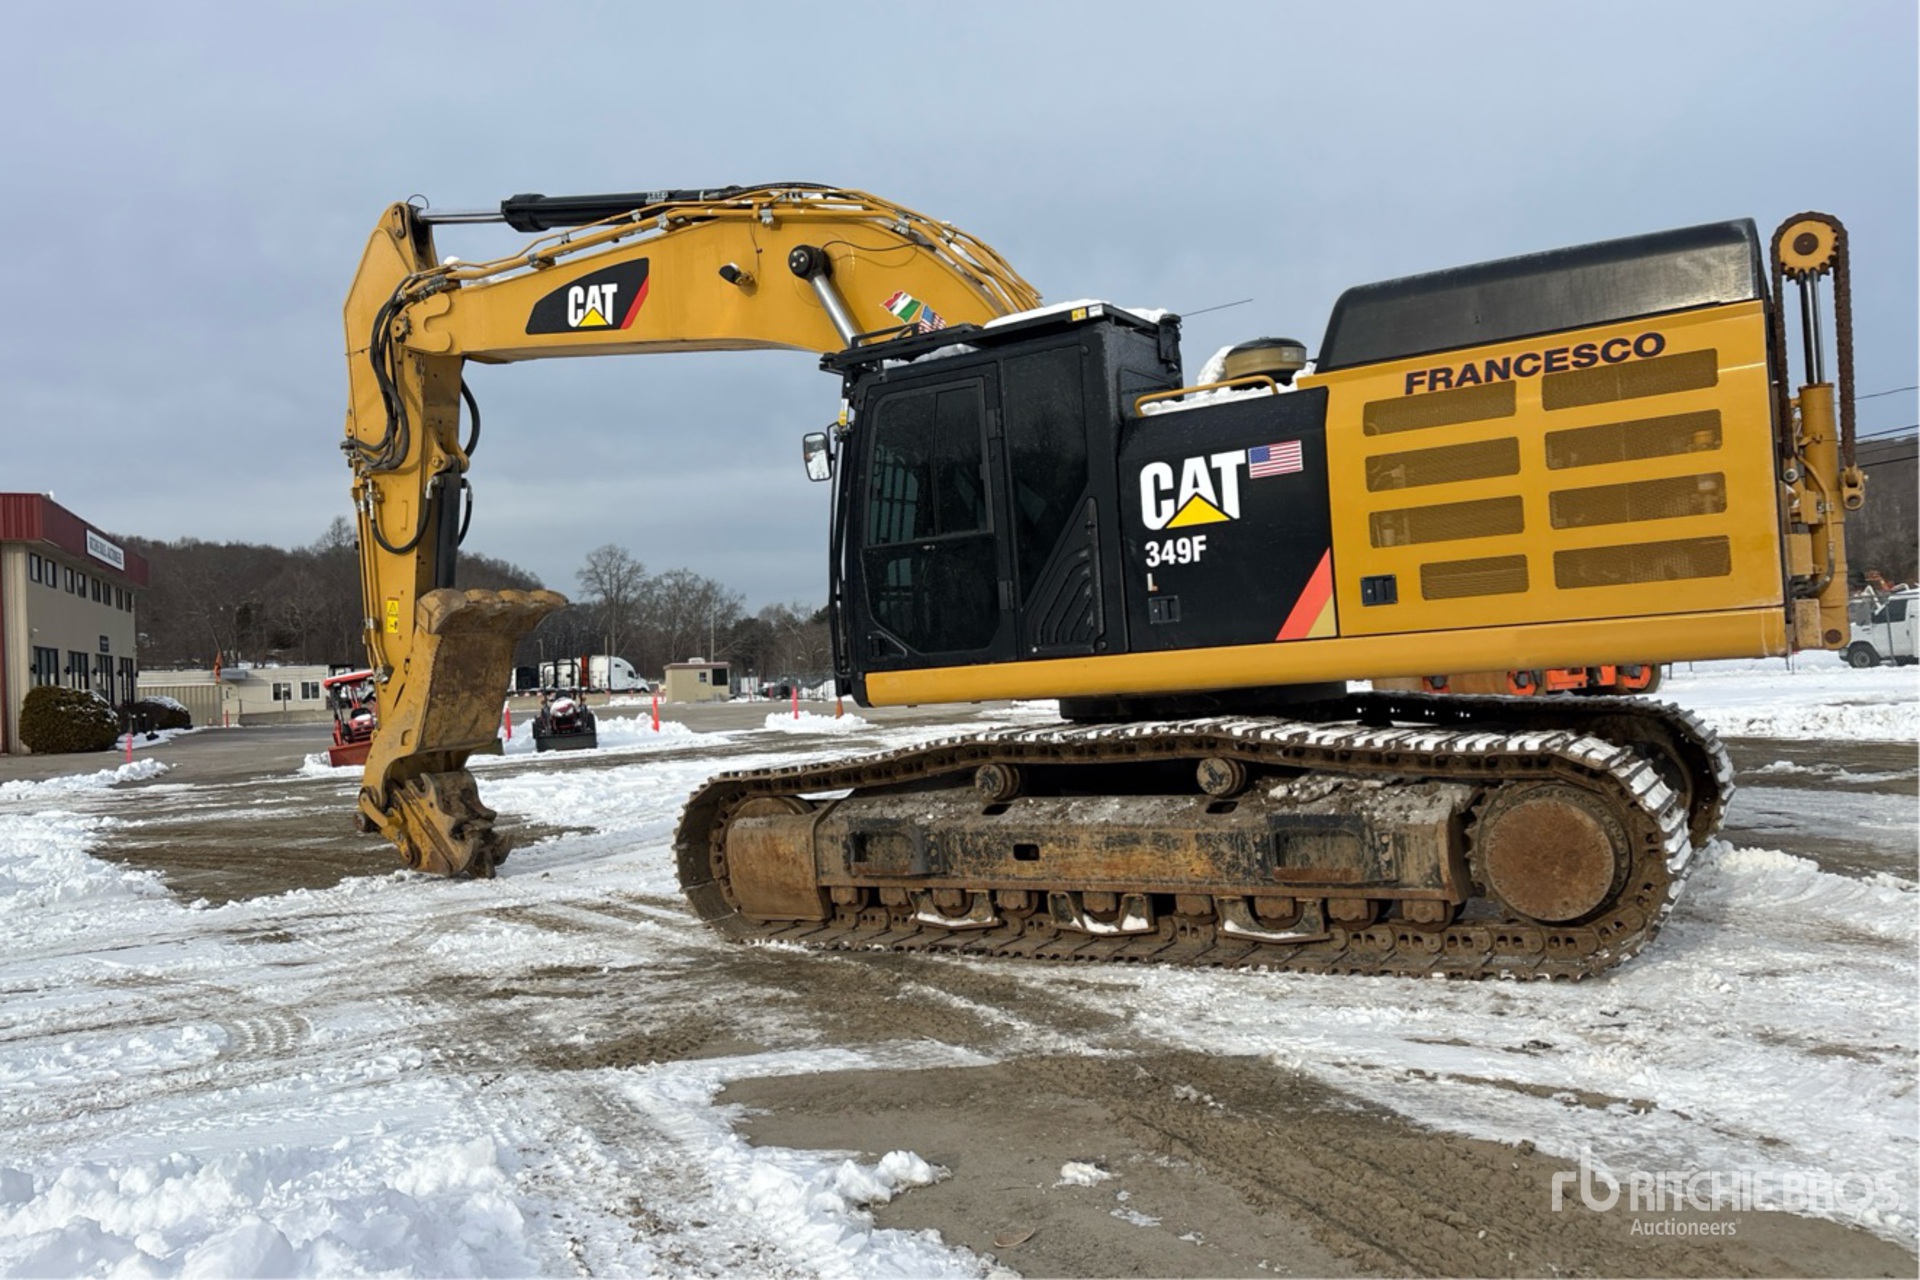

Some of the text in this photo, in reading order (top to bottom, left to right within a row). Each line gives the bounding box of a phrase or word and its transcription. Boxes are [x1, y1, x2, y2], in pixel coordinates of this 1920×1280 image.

[567, 284, 618, 328] CAT
[1405, 332, 1665, 395] FRANCESCO
[1139, 449, 1246, 531] CAT
[1145, 534, 1207, 568] 349F
[1147, 573, 1158, 592] L
